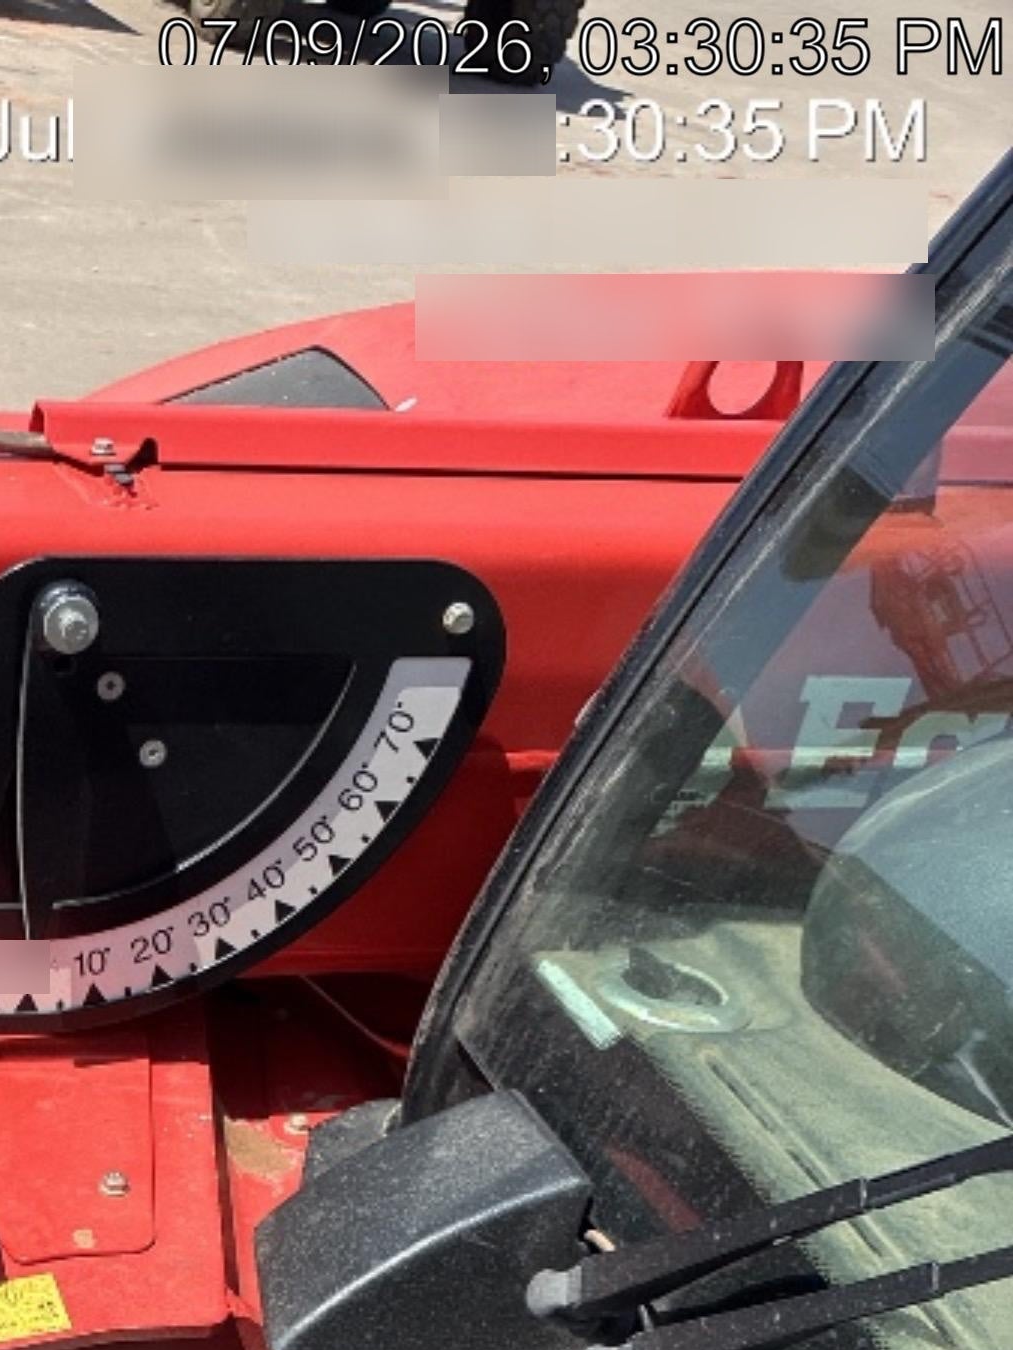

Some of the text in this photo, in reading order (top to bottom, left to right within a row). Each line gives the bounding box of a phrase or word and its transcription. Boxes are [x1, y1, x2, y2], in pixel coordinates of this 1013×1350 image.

[73, 701, 414, 976] 10° 20° 30° 40° 50° 60° 70°
